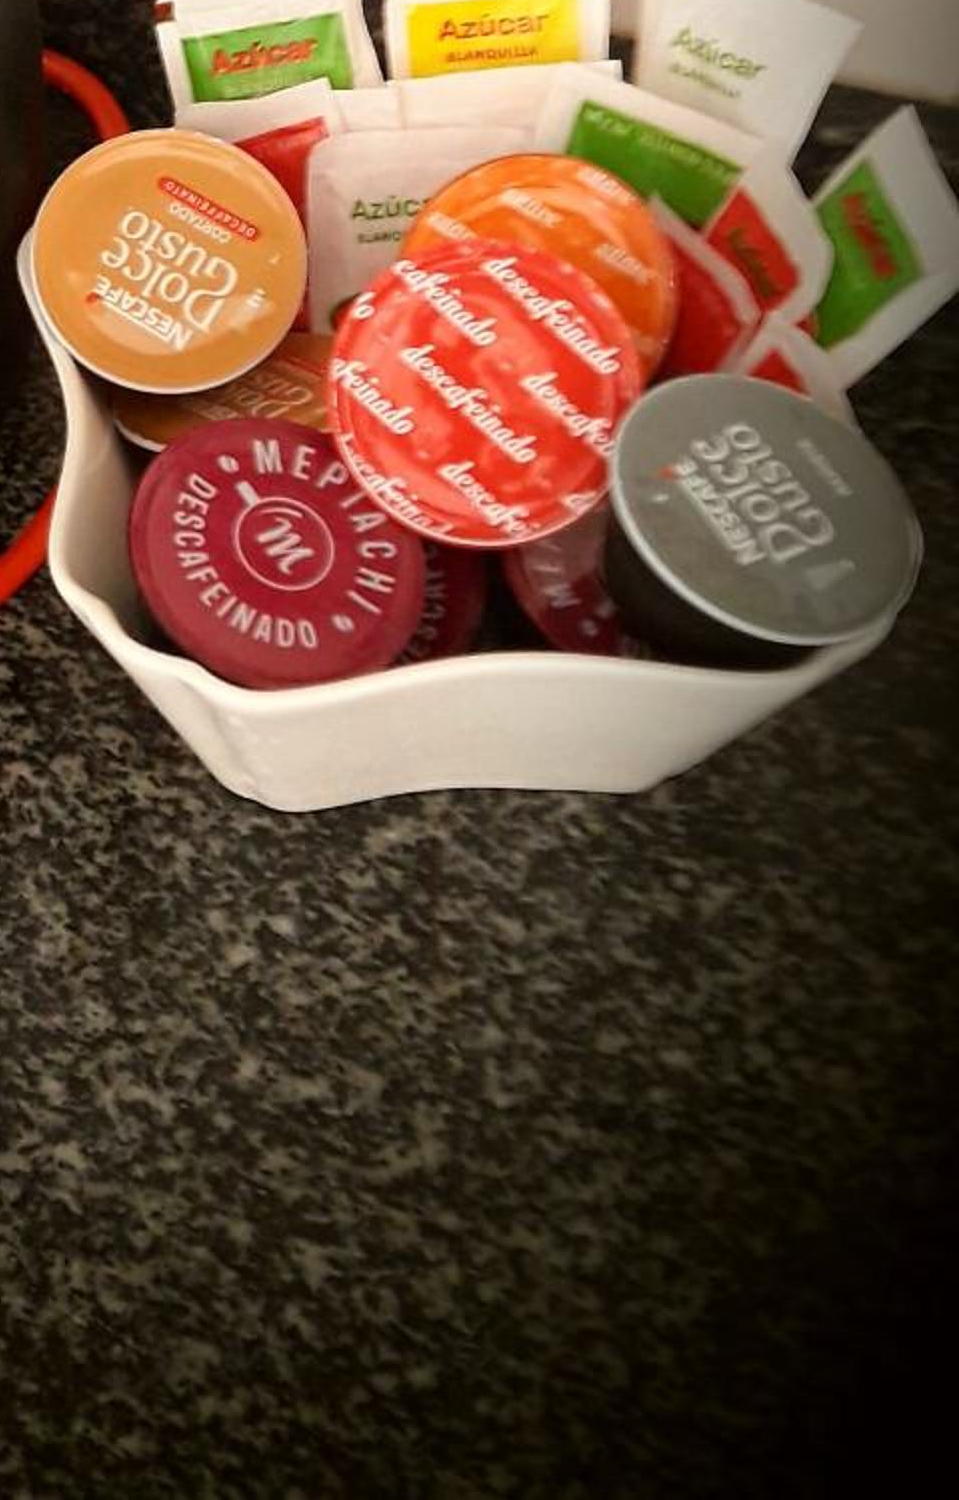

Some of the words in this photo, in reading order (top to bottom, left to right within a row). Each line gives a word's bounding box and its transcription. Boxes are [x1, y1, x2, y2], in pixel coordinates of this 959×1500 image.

[212, 36, 318, 76] Azúcar
[439, 13, 550, 41] Azúcar
[169, 202, 233, 244] CORTADO
[481, 257, 621, 374] descafeinado
[399, 344, 538, 463] descafeinado
[172, 472, 320, 649] DESCAFEINADO
